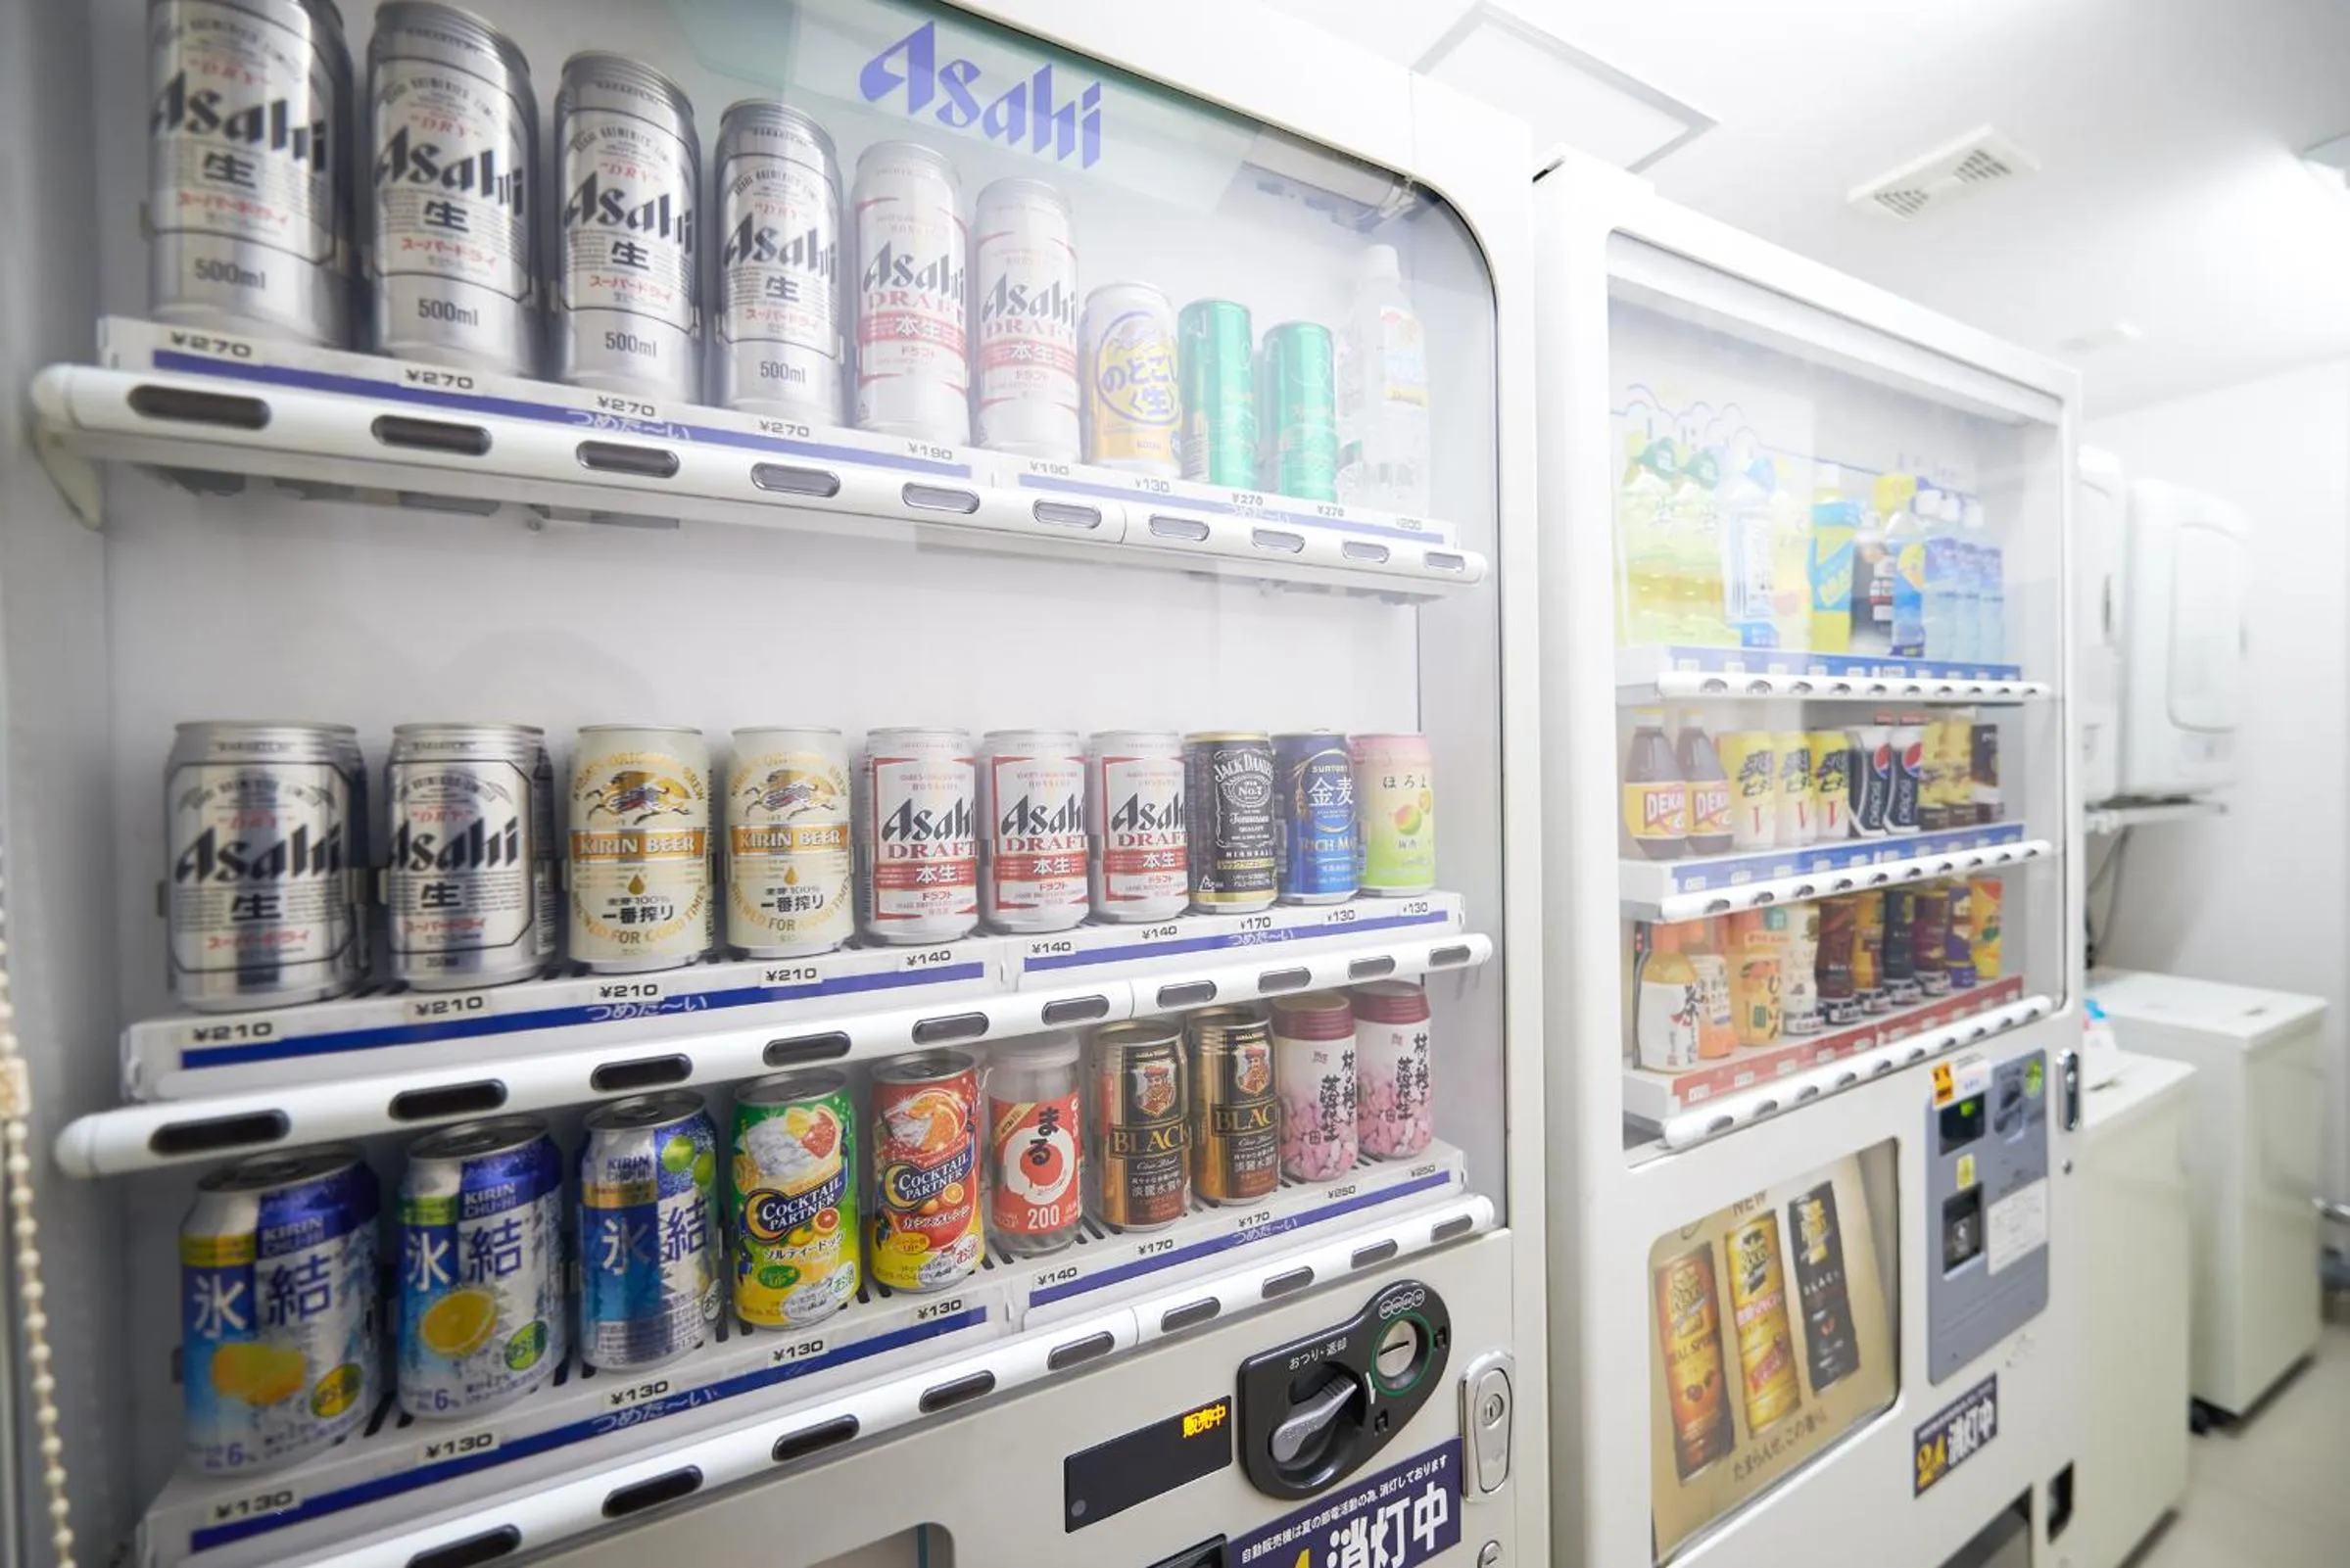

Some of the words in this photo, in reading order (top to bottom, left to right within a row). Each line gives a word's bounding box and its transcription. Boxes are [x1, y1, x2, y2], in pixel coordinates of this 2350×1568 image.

[859, 20, 1101, 169] Asahi
[149, 71, 326, 173] Asahi
[204, 152, 257, 190] 生
[373, 125, 523, 216] Asahi
[177, 191, 289, 224] スーパードライ
[423, 201, 471, 233] 生
[563, 170, 693, 255] Asahi
[400, 237, 498, 267] スーパードライ
[611, 240, 650, 271] 生
[723, 212, 837, 284] Asahi
[194, 259, 266, 290] 500ml
[863, 240, 964, 307] Asahi
[590, 275, 672, 300] スーパードライ
[765, 274, 800, 303] 生
[417, 298, 479, 326] 500ml
[983, 271, 1076, 330] Asahi
[894, 316, 940, 339] 本生
[169, 331, 253, 358] ¥270
[604, 331, 657, 358] 500ml
[1012, 343, 1055, 361] 本生
[405, 368, 475, 390] ¥270
[760, 360, 806, 384] 500ml
[597, 395, 655, 416] ¥270
[758, 419, 810, 438] ¥270
[907, 441, 953, 460] ¥190
[1030, 459, 1070, 476] ¥190
[1134, 477, 1171, 493] ¥130
[1231, 493, 1264, 506] ¥270
[1214, 758, 1243, 783] JACK
[1312, 765, 1348, 774] SUNTORY
[1308, 776, 1355, 807] 金麦
[882, 796, 974, 841] Asahi
[1000, 792, 1086, 835] Asahi
[1111, 791, 1184, 832] Asah
[389, 816, 518, 873] Asahi
[579, 837, 638, 855] KIRIN
[646, 835, 695, 854] BEER
[741, 832, 791, 849] KIRIN
[798, 830, 841, 847] BEER
[887, 840, 978, 859] DRAFT
[1006, 833, 1088, 852] DRAFT
[175, 823, 343, 883] Asahi
[1142, 854, 1175, 870] 本生
[916, 865, 958, 884] 本生
[1032, 857, 1073, 875] 本生
[230, 893, 282, 922] 生
[421, 881, 462, 909] 生
[760, 893, 825, 913] 一番搾り
[601, 904, 674, 925] 一番搾り
[1326, 909, 1356, 922] ¥130
[1402, 901, 1429, 915] ¥130
[405, 917, 486, 935] スーパードライ
[768, 918, 796, 931] FOR
[1141, 926, 1178, 939] ¥140
[1239, 916, 1272, 930] ¥170
[207, 928, 311, 950] スーパードライ
[1031, 940, 1073, 954] ¥140
[906, 949, 952, 967] ¥140
[765, 967, 818, 981] ¥210
[599, 983, 658, 998] ¥210
[414, 995, 484, 1016] ¥210
[192, 1022, 274, 1043] ¥210
[1029, 1106, 1060, 1166] まる
[1113, 1122, 1189, 1154] BLACK
[606, 1156, 651, 1171] KIRIN
[898, 1152, 970, 1192] COCKTAIL
[1410, 1164, 1436, 1177] ¥250
[464, 1181, 516, 1206] KIRIN
[905, 1167, 963, 1201] PARTNER
[1327, 1185, 1357, 1200] ¥250
[464, 1197, 518, 1220] CHU-HI
[761, 1175, 843, 1222] COCKTAIL
[770, 1193, 836, 1231] PARTNER
[1027, 1205, 1060, 1230] 200
[1238, 1211, 1271, 1227] ¥170
[262, 1215, 324, 1242] KIRIN
[601, 1197, 707, 1276] 氷結
[405, 1217, 524, 1293] 氷結
[1136, 1238, 1174, 1256] ¥170
[1036, 1266, 1078, 1286] ¥140
[193, 1255, 333, 1341] 氷結
[917, 1298, 962, 1320] ¥130
[772, 1339, 825, 1362] ¥130
[610, 1379, 669, 1405] ¥130
[1183, 1402, 1226, 1439] 販売中
[424, 1432, 494, 1459] ¥130
[214, 1490, 294, 1520] ¥130
[1325, 1481, 1449, 1568] 消灯中
